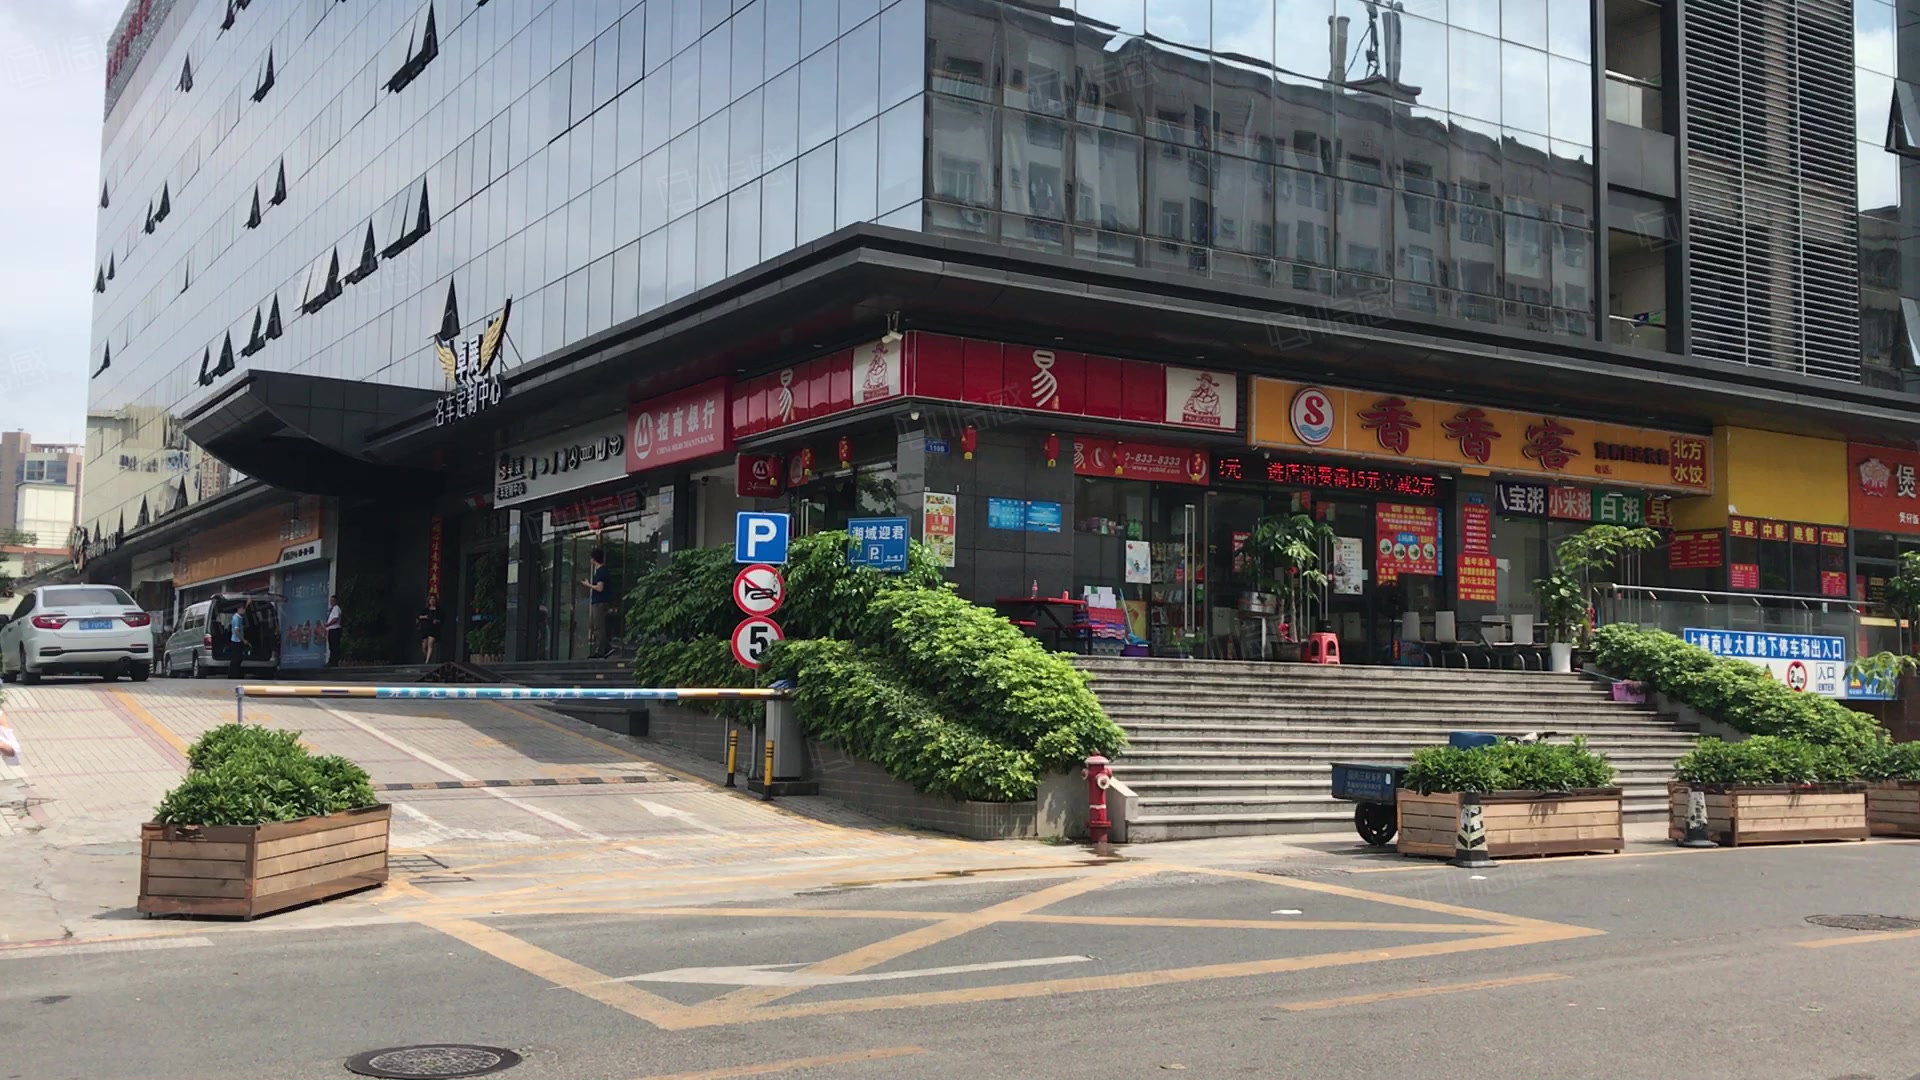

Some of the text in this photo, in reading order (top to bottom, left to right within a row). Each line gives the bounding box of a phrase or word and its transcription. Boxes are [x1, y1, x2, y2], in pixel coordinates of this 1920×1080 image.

[456, 335, 480, 383] 卓展
[435, 376, 502, 427] 名车定制中心
[657, 399, 716, 441] 招商银行
[1357, 397, 1581, 470] 香香客
[1673, 439, 1702, 461] 北方
[1673, 463, 1704, 484] 水饺
[1495, 484, 1545, 514] 八宝粥
[1549, 489, 1591, 519] 小米粥
[1600, 494, 1639, 523] 白粥
[747, 518, 777, 557] P
[852, 525, 905, 541] 湘域迎君
[1732, 520, 1754, 536] 早餐
[1763, 523, 1784, 539] 中餐
[1794, 526, 1814, 542] 晚餐
[749, 626, 769, 661] 5
[1818, 666, 1834, 680] 入口
[1818, 683, 1834, 692] ENTER
